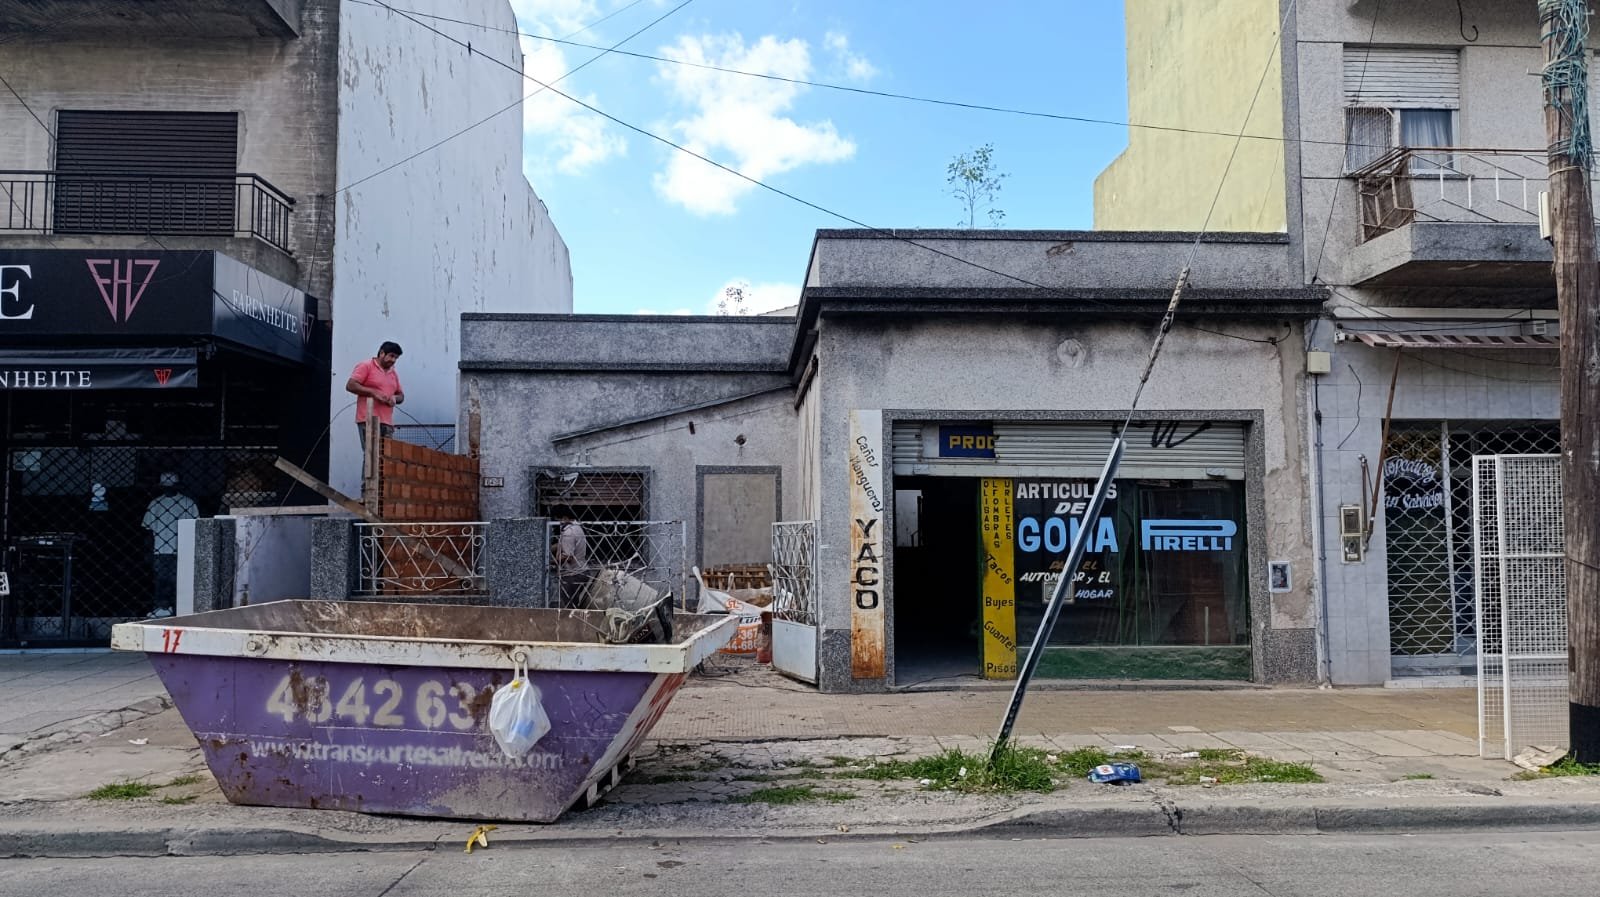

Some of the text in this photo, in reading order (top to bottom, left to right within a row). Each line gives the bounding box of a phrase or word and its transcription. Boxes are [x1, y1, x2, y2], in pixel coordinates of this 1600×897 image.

[232, 289, 298, 335] FARENHEITE
[856, 436, 879, 467] Caños
[1016, 482, 1118, 500] ARTICULS
[1054, 502, 1086, 515] DE
[1141, 519, 1238, 551] PIRELLI
[855, 518, 879, 610] YACO
[985, 554, 1012, 585] Tacos
[1098, 571, 1111, 583] EL
[985, 596, 1014, 610] Bujes
[1074, 589, 1114, 599] HOGAR
[162, 628, 183, 654] 17
[984, 620, 1016, 653] Guantes
[986, 662, 1016, 673] Pisos
